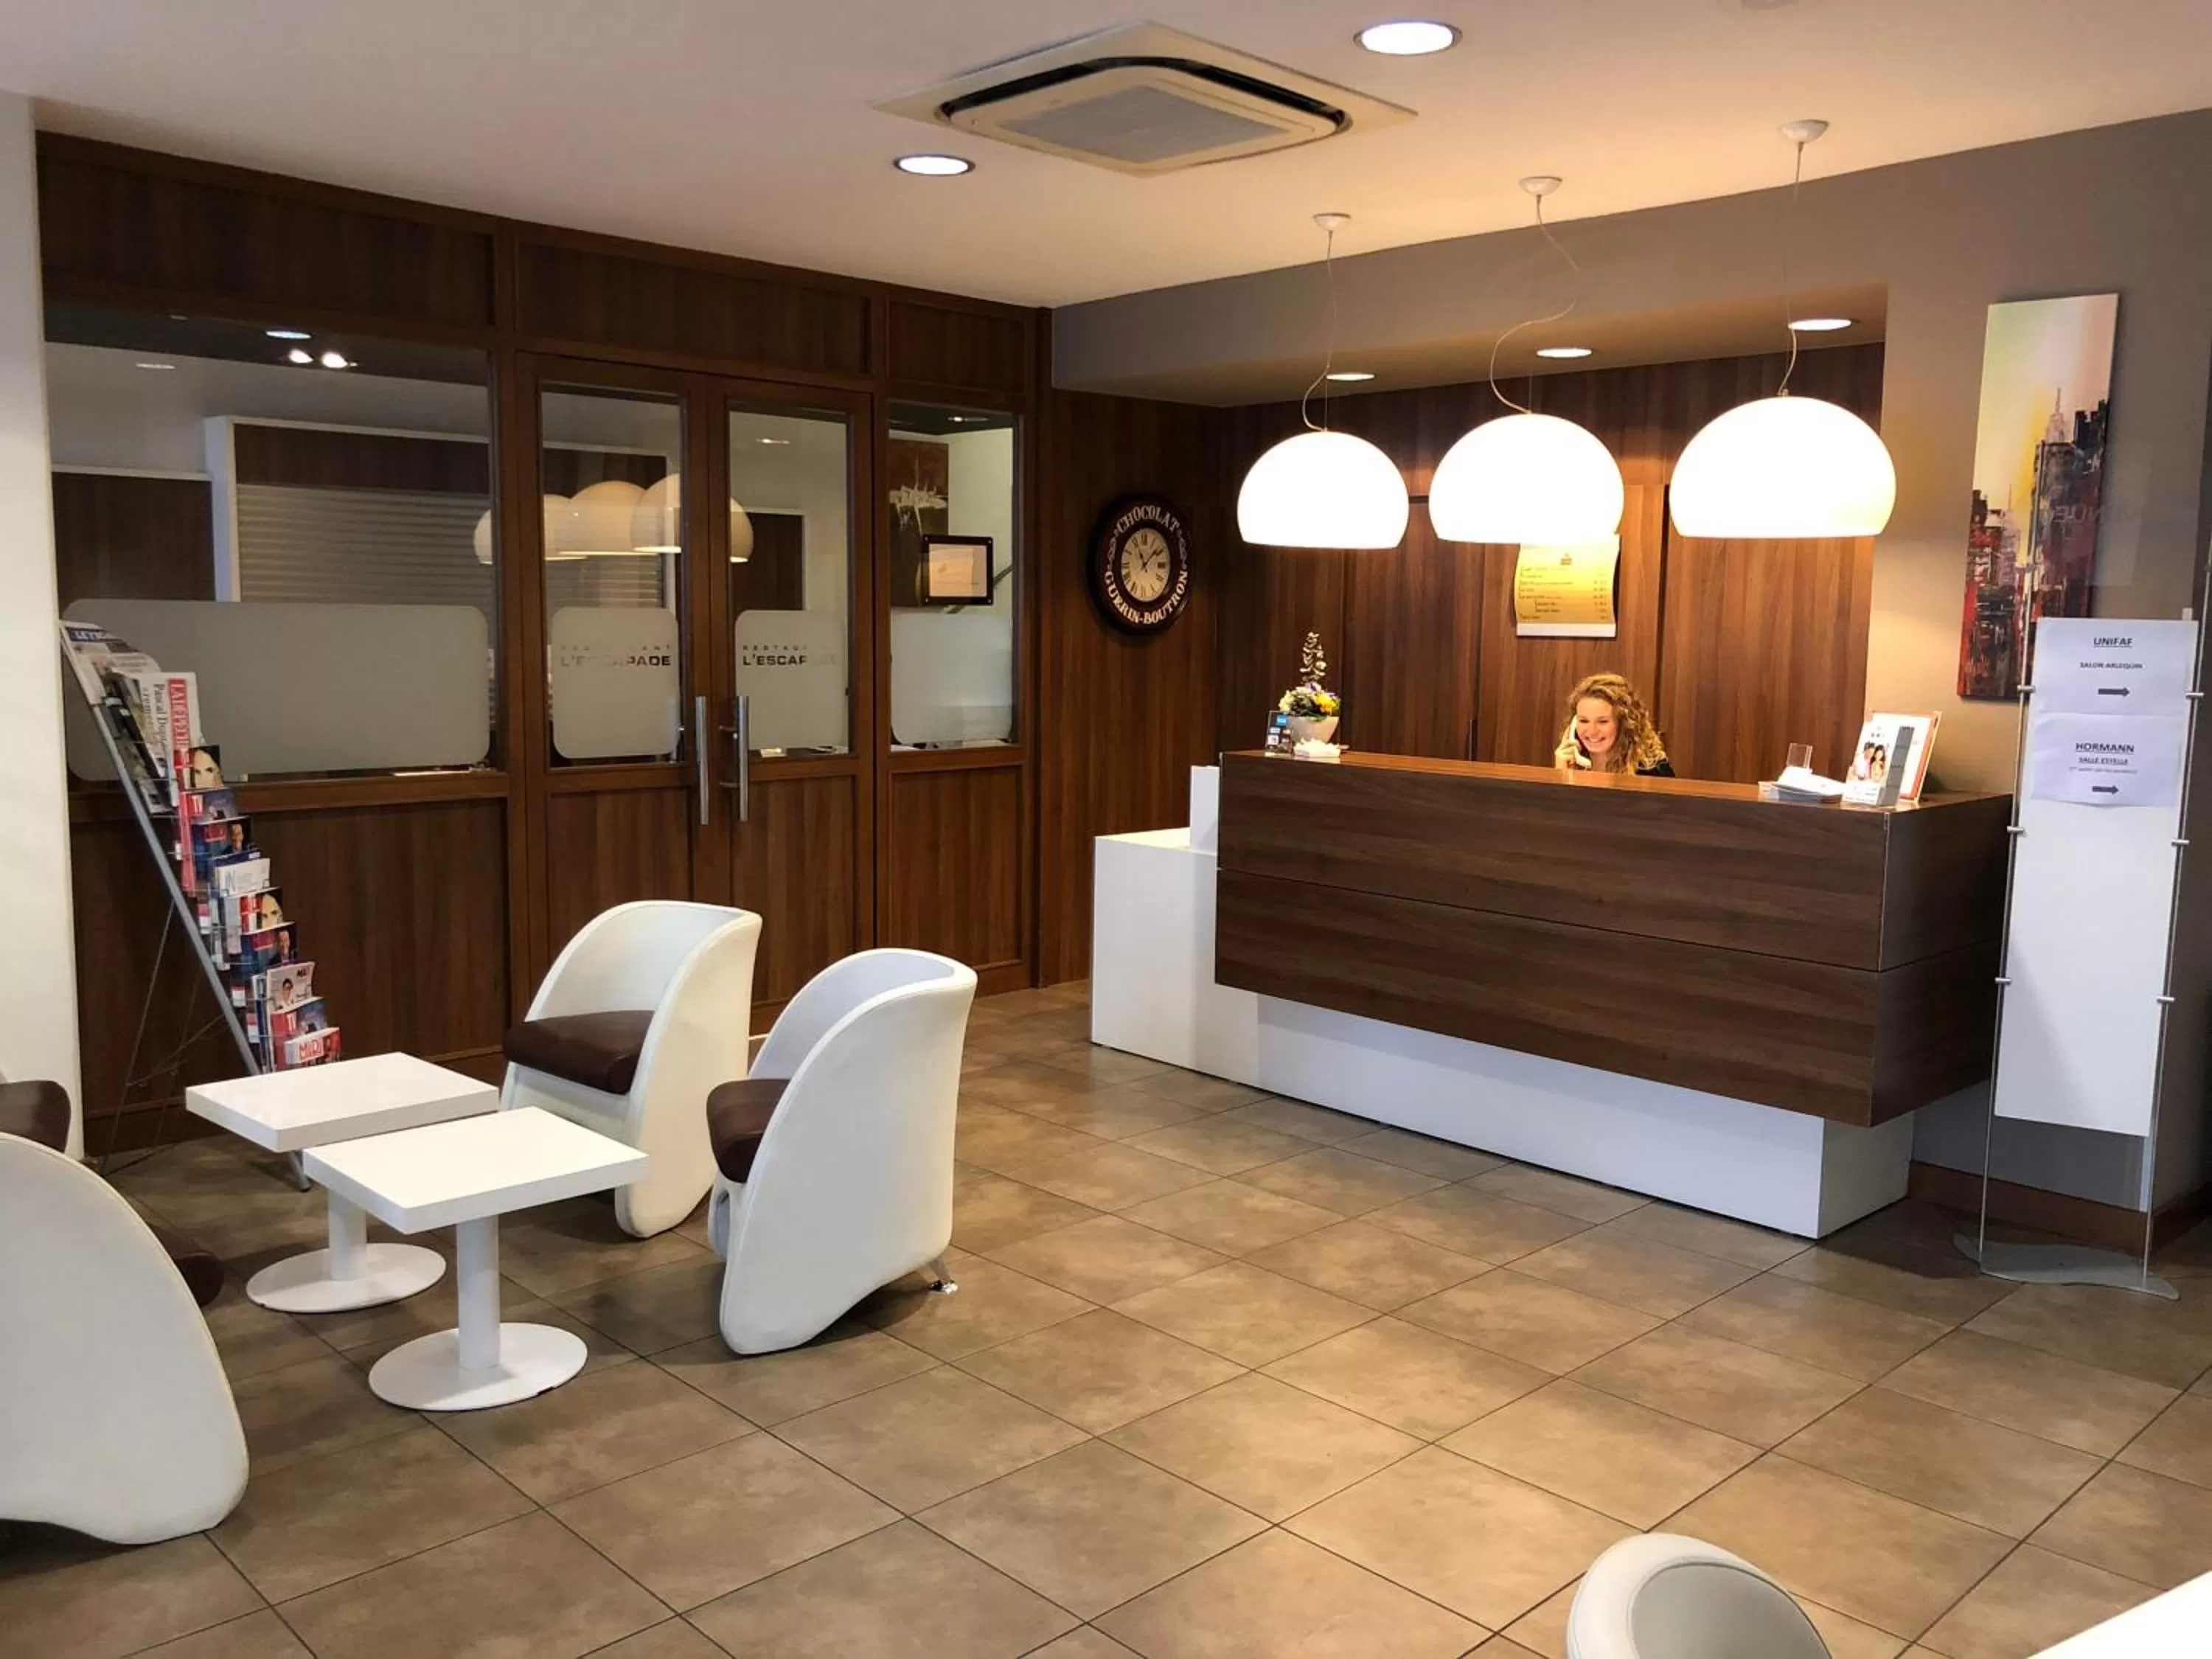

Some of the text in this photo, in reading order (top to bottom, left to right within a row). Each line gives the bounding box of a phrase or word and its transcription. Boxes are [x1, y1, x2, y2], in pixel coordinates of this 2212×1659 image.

[1116, 505, 1180, 533] CHOCOLAT
[2093, 636, 2133, 647] UNIFAF
[560, 653, 671, 667] L'EPADE
[2076, 742, 2135, 753] HORMANN
